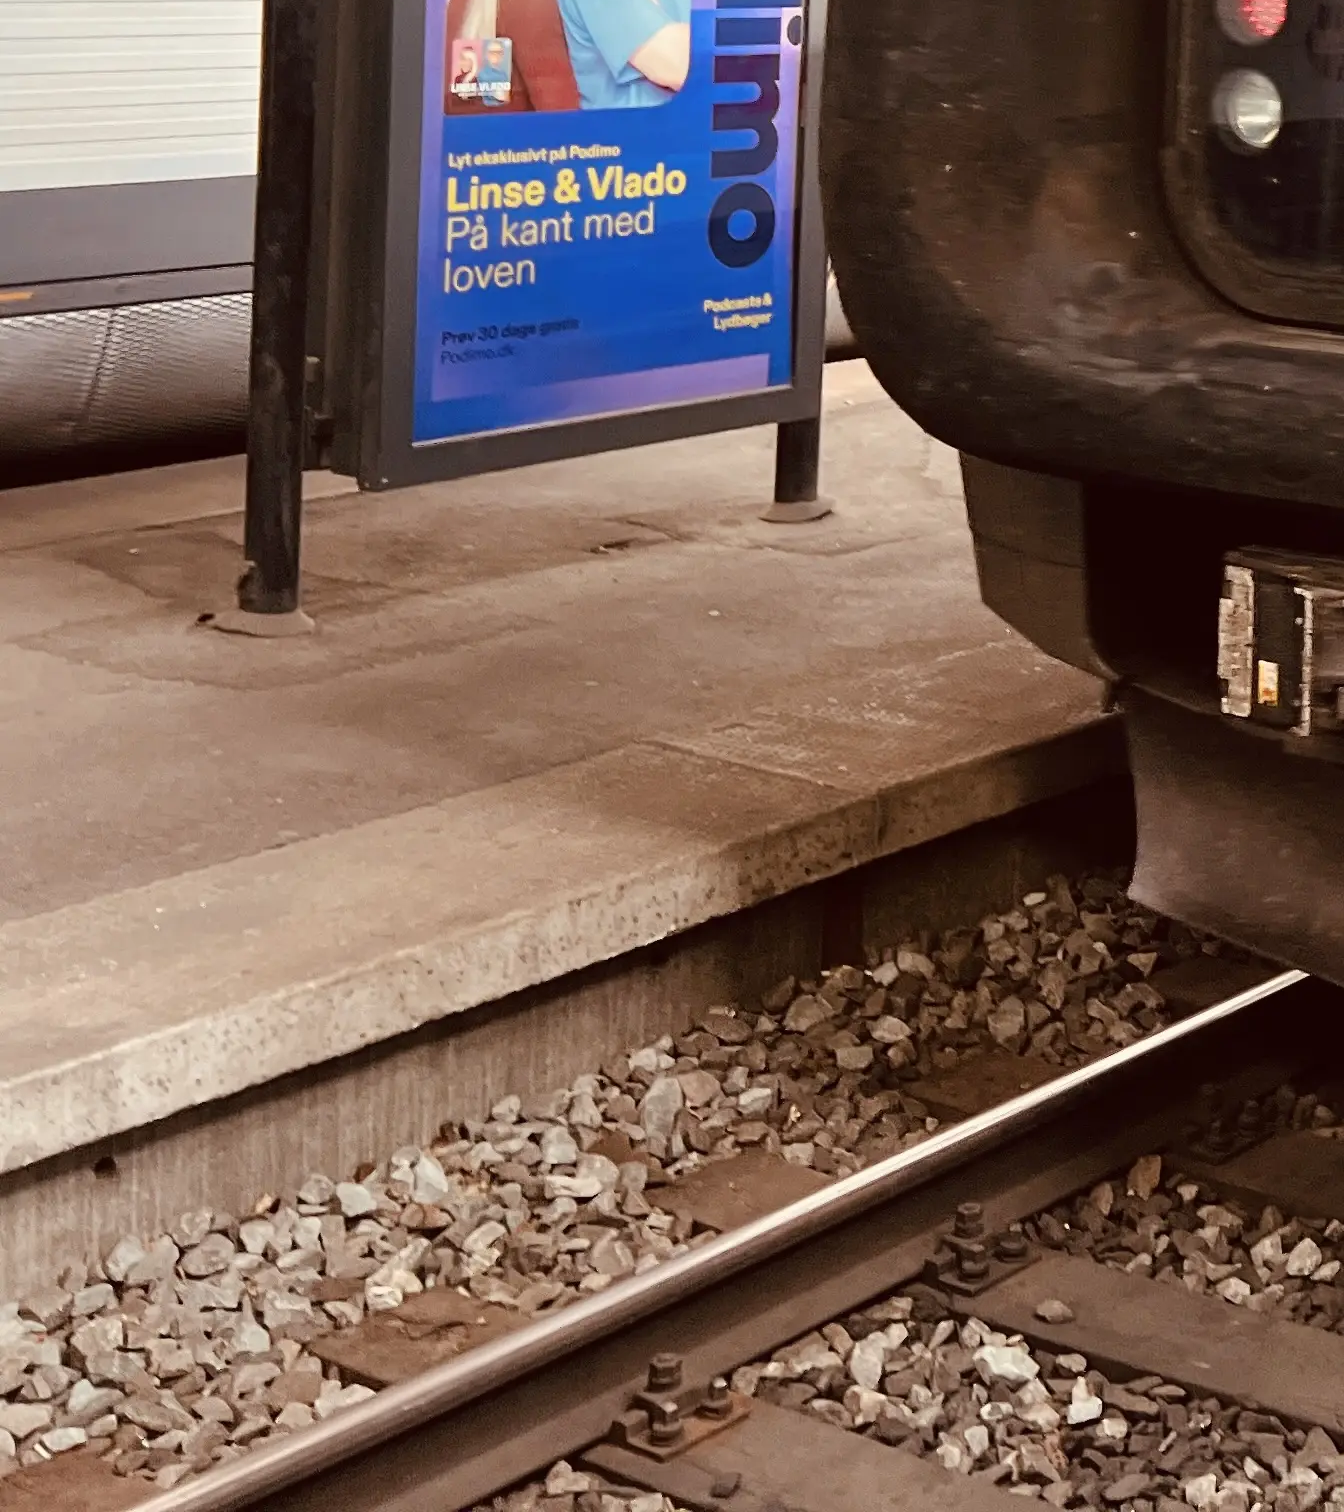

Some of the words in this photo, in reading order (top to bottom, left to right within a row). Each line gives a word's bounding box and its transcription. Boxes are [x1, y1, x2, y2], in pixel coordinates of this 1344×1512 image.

[448, 152, 472, 171] Lyt
[474, 147, 547, 166] eksklusivt
[549, 146, 567, 164] på
[569, 144, 620, 159] Podimo
[447, 175, 546, 212] Linse
[553, 168, 581, 204] &
[587, 161, 687, 201] Vlado
[446, 214, 488, 253] På
[501, 210, 574, 248] kant
[584, 201, 655, 240] med
[443, 258, 536, 294] loven
[477, 325, 499, 341] 30
